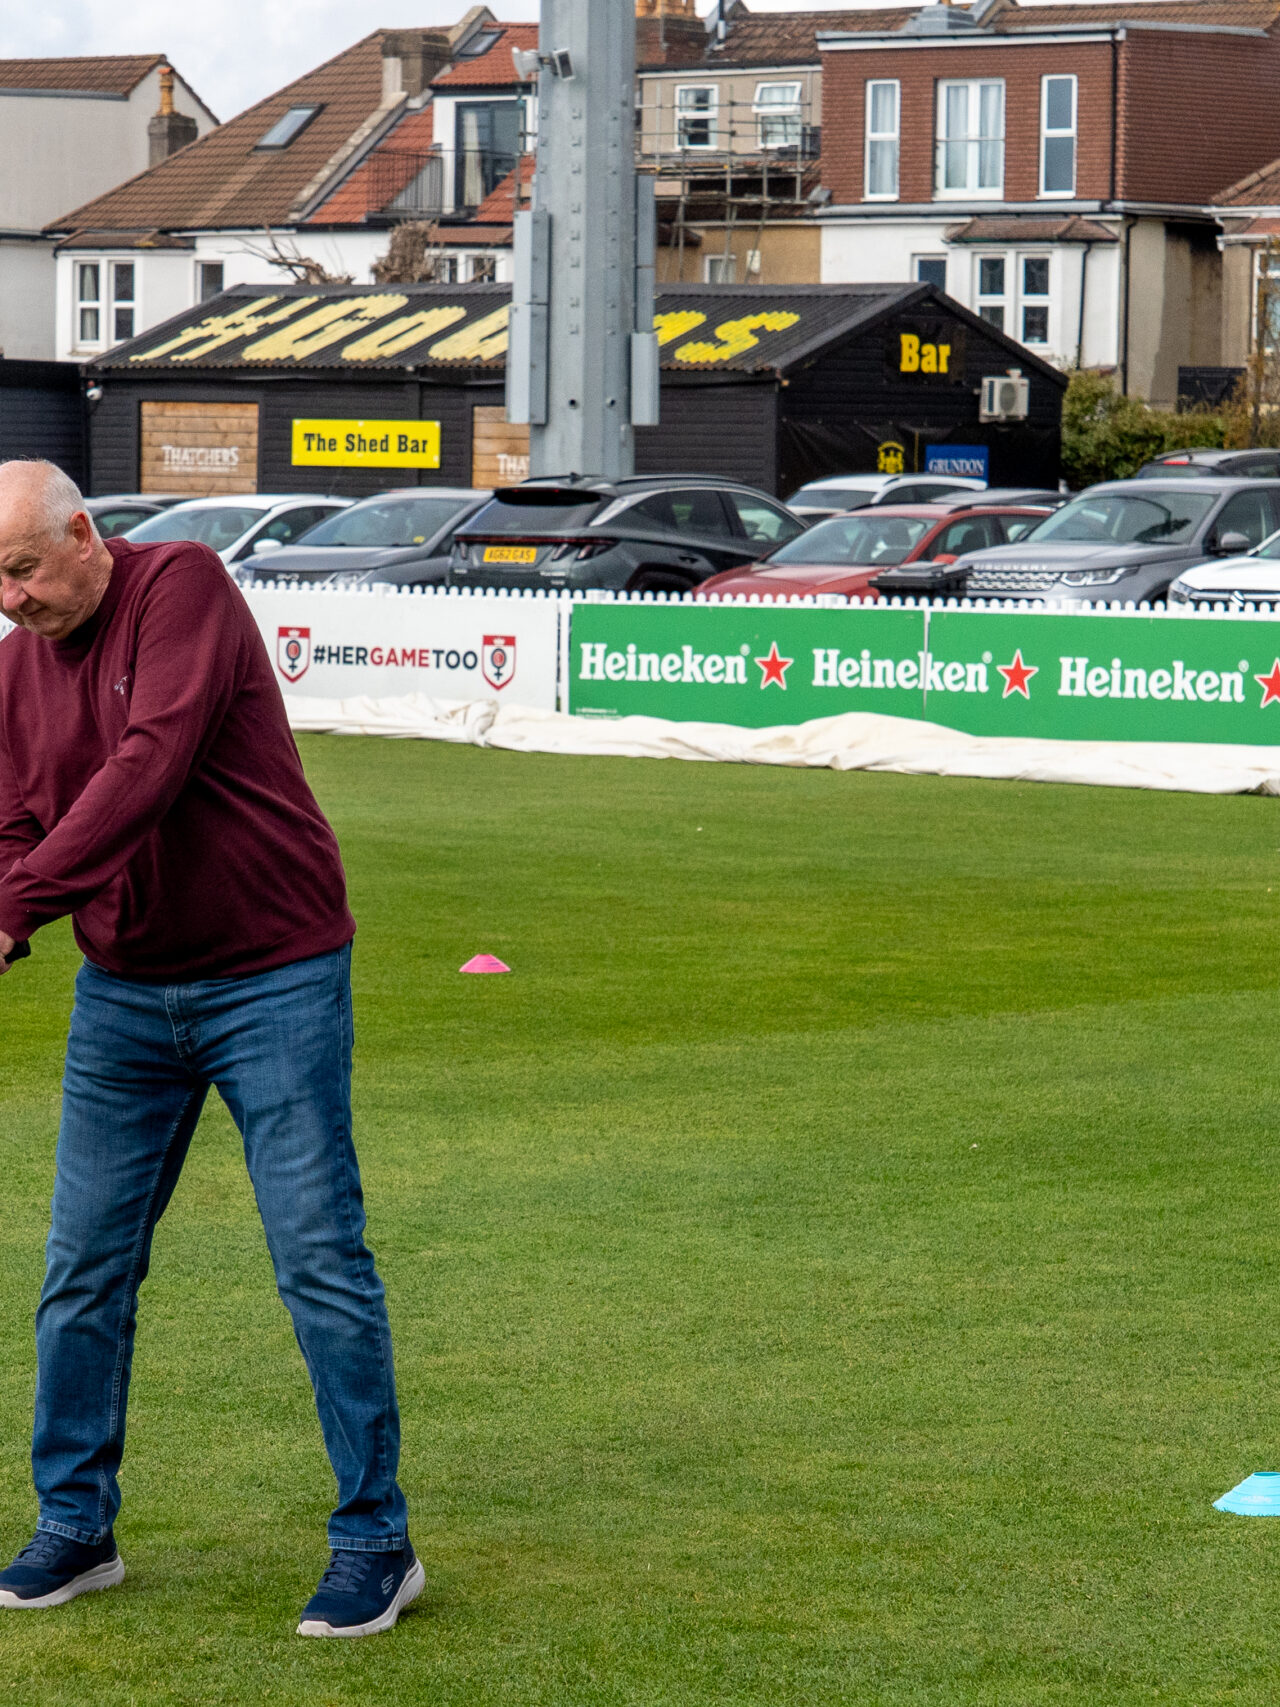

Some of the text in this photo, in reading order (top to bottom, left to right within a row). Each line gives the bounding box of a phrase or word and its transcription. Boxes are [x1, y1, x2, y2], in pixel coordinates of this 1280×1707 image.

[900, 333, 951, 374] Bar
[303, 433, 428, 453] The Shed Bar
[928, 458, 985, 474] GRUNDON
[313, 645, 479, 670] #HERGAMETOO
